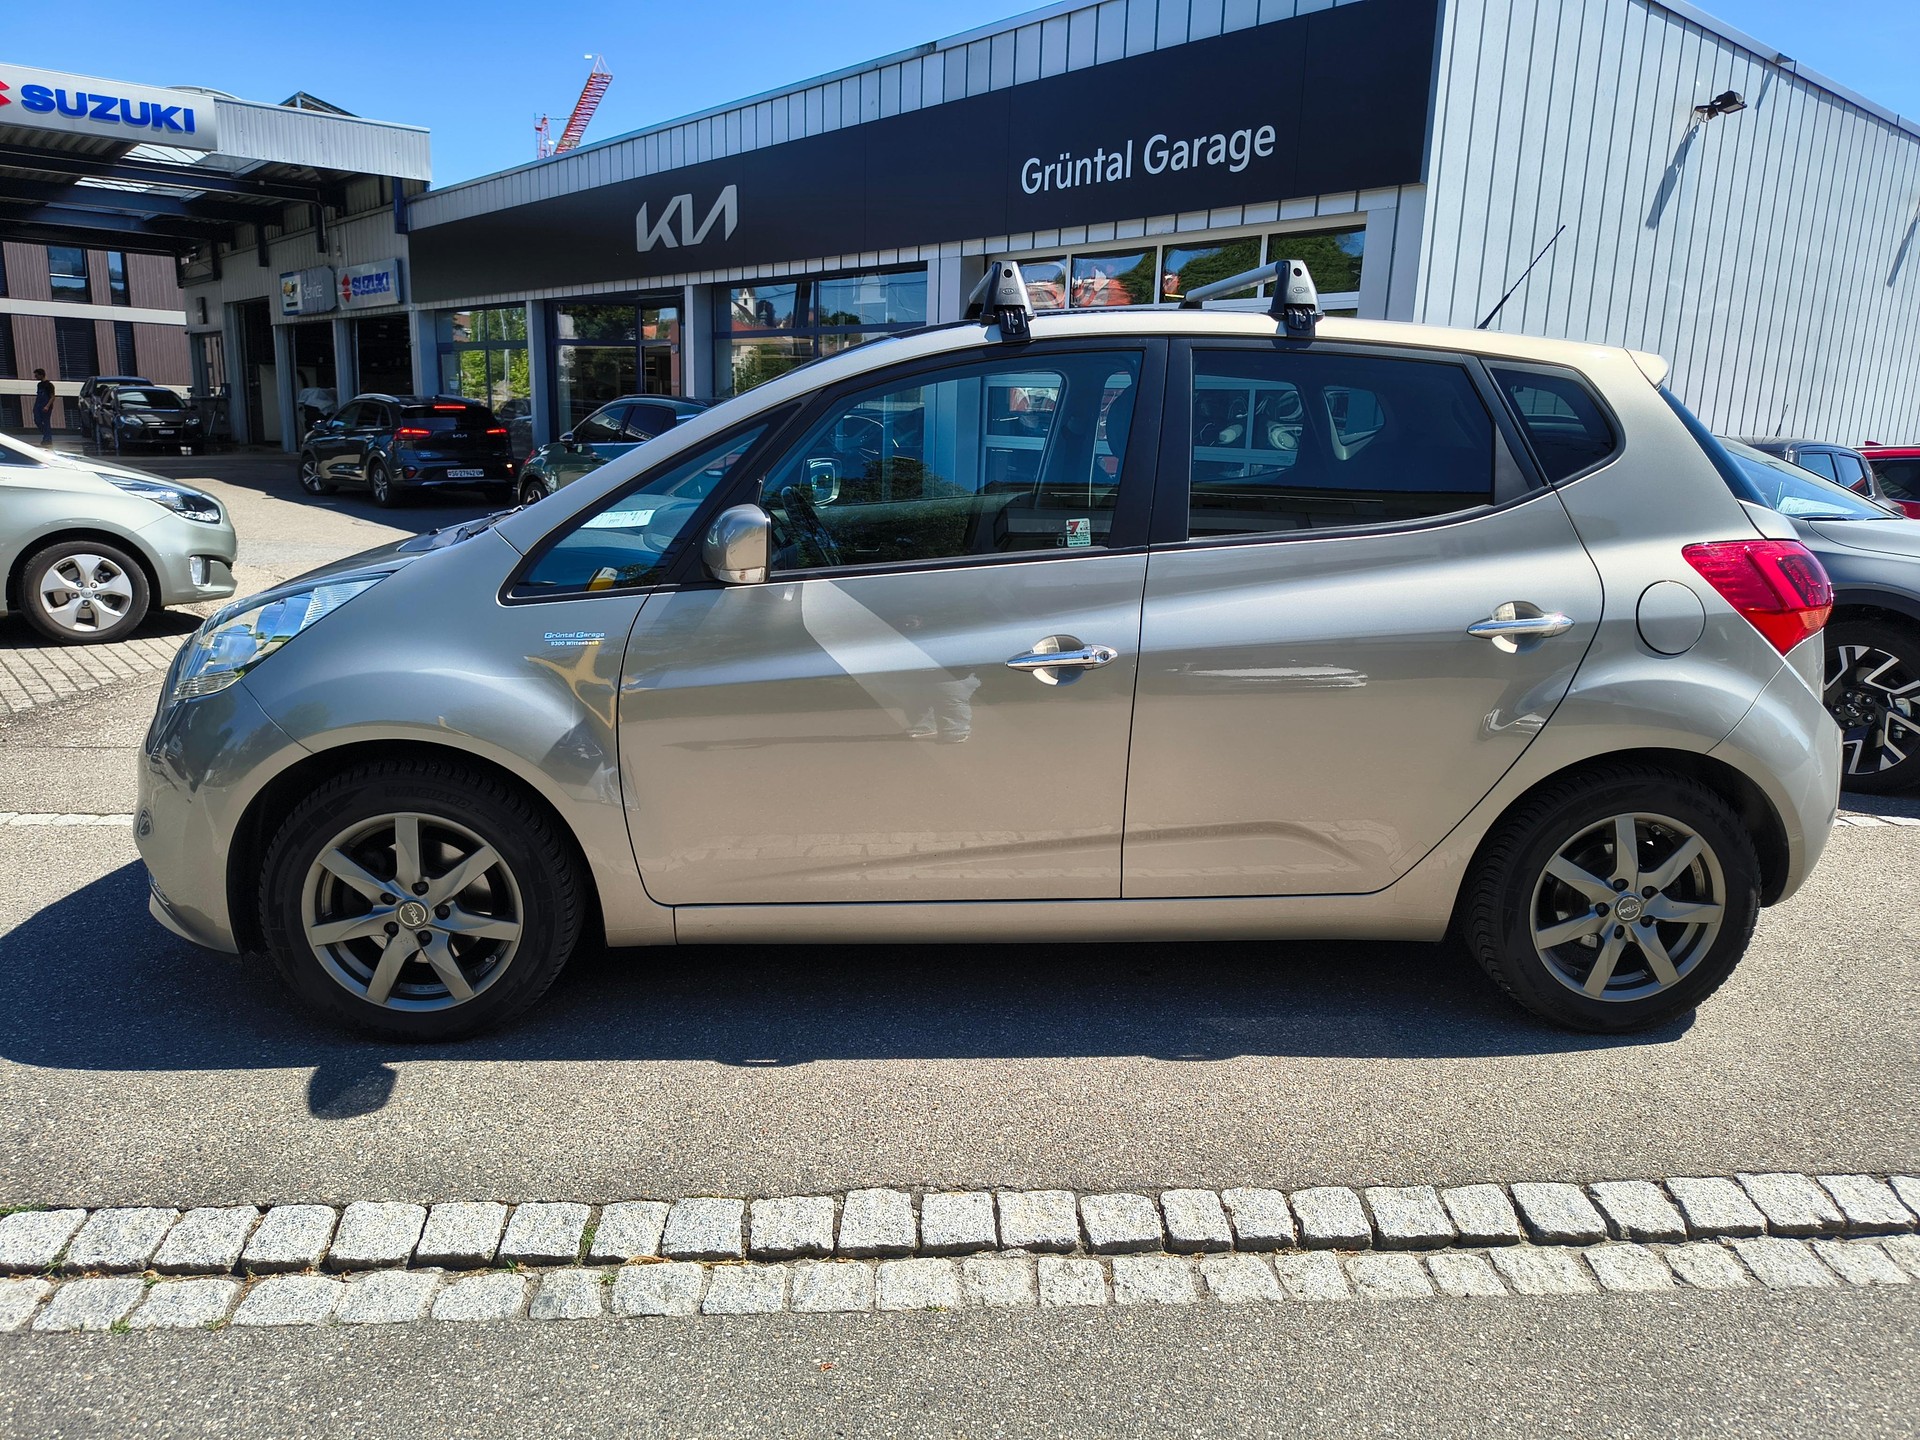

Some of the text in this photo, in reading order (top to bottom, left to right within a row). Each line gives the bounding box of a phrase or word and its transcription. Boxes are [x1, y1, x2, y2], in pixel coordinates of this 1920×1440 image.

[20, 84, 196, 134] SUZUKI
[1021, 124, 1276, 195] Grüntal Garage
[636, 184, 738, 252] KIA
